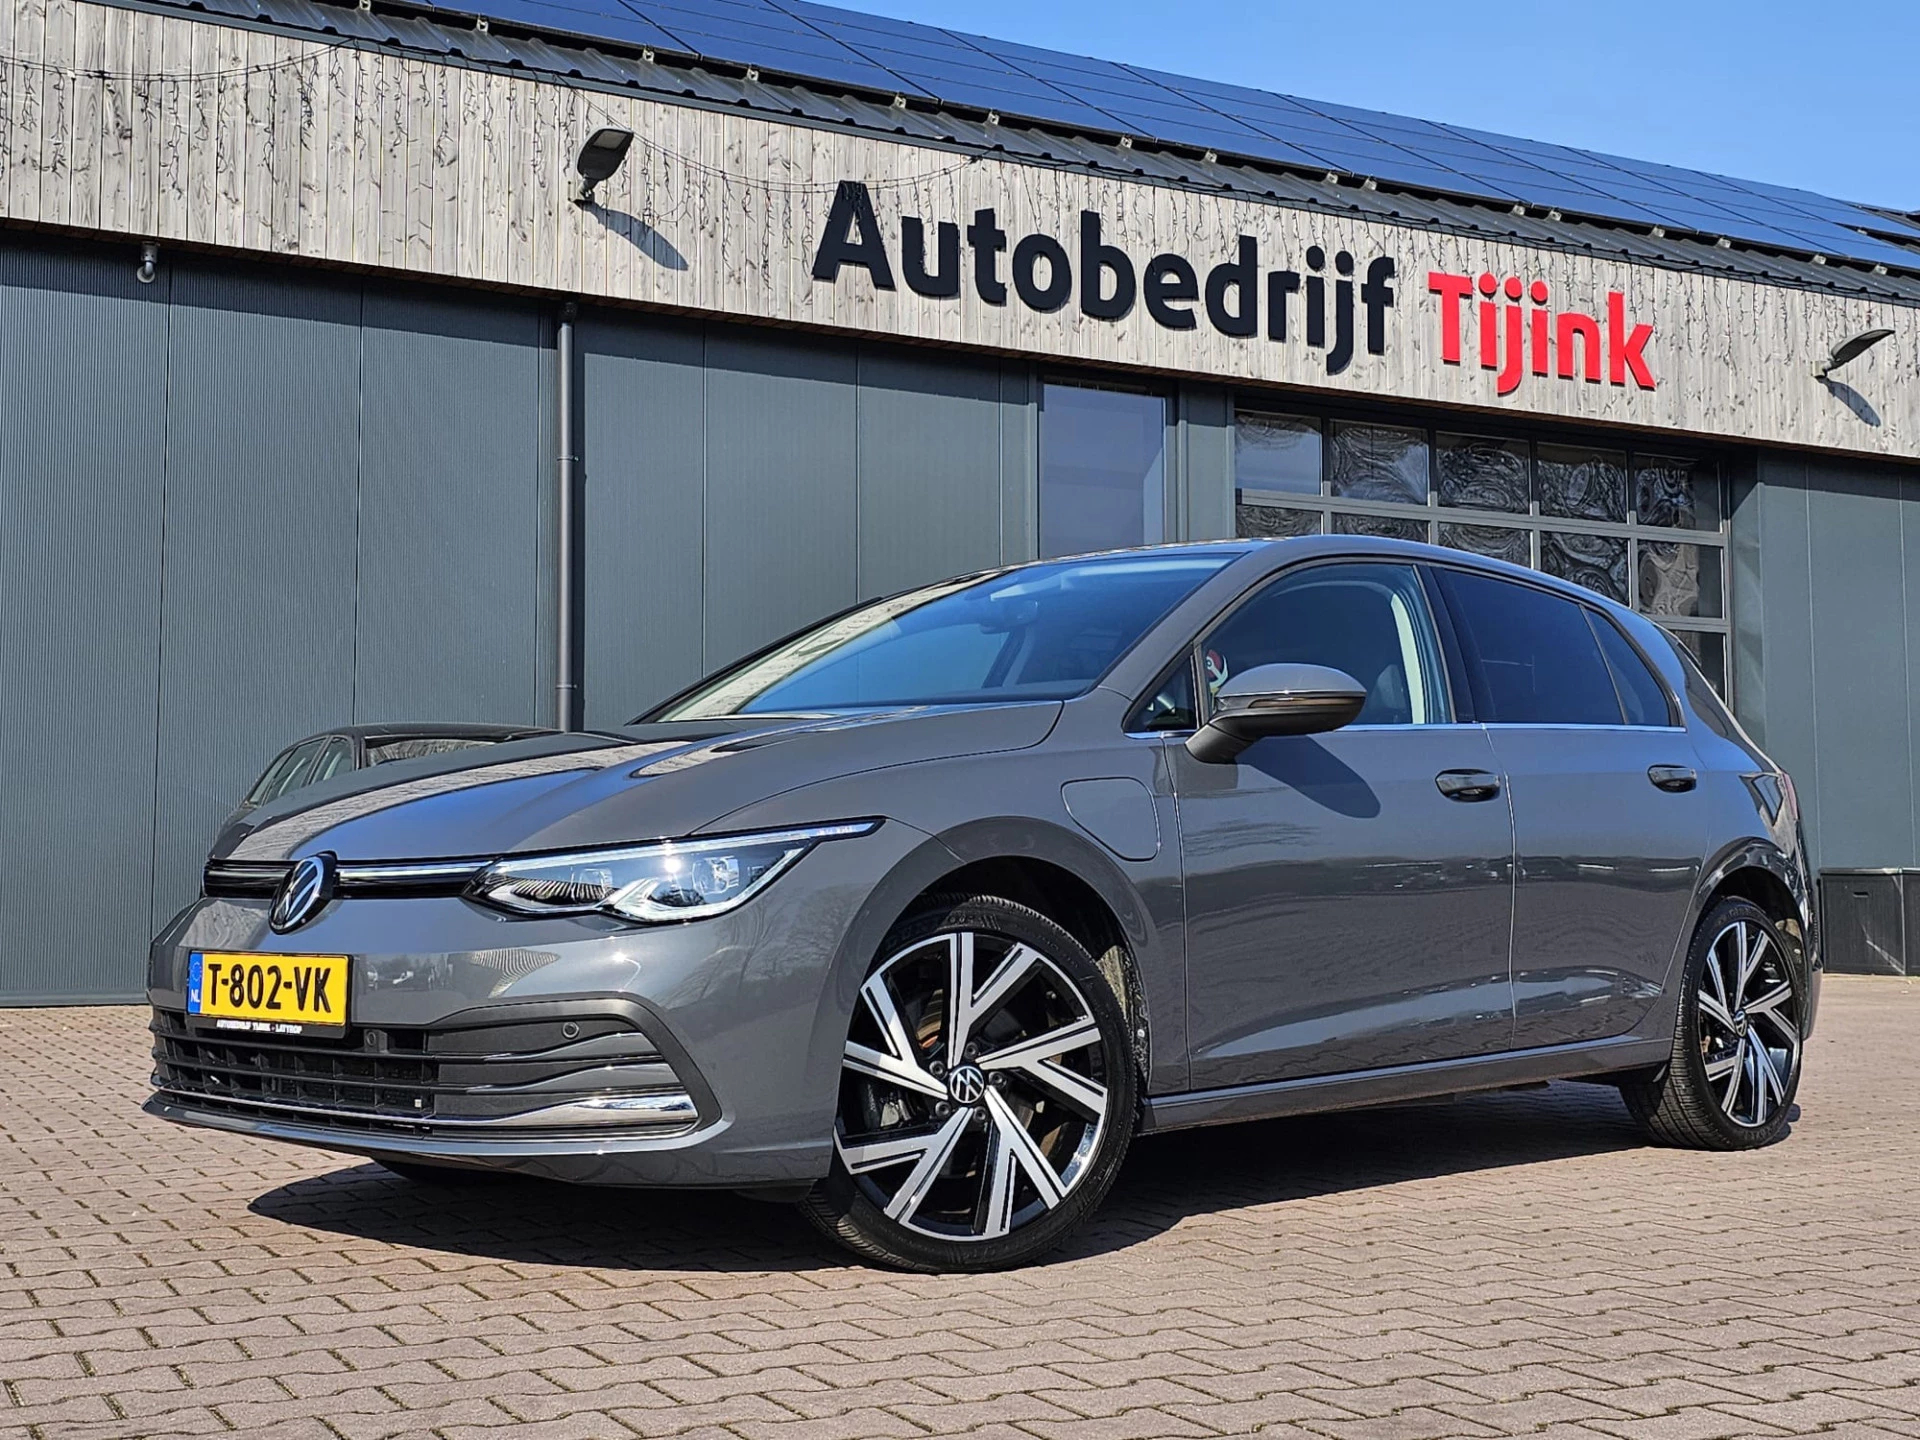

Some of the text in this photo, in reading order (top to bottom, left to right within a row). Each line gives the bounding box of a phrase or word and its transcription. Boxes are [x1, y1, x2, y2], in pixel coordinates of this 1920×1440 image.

[811, 180, 1655, 393] Autobedrijf Tijink
[190, 988, 201, 1003] NL
[208, 963, 332, 1013] T-802-VK
